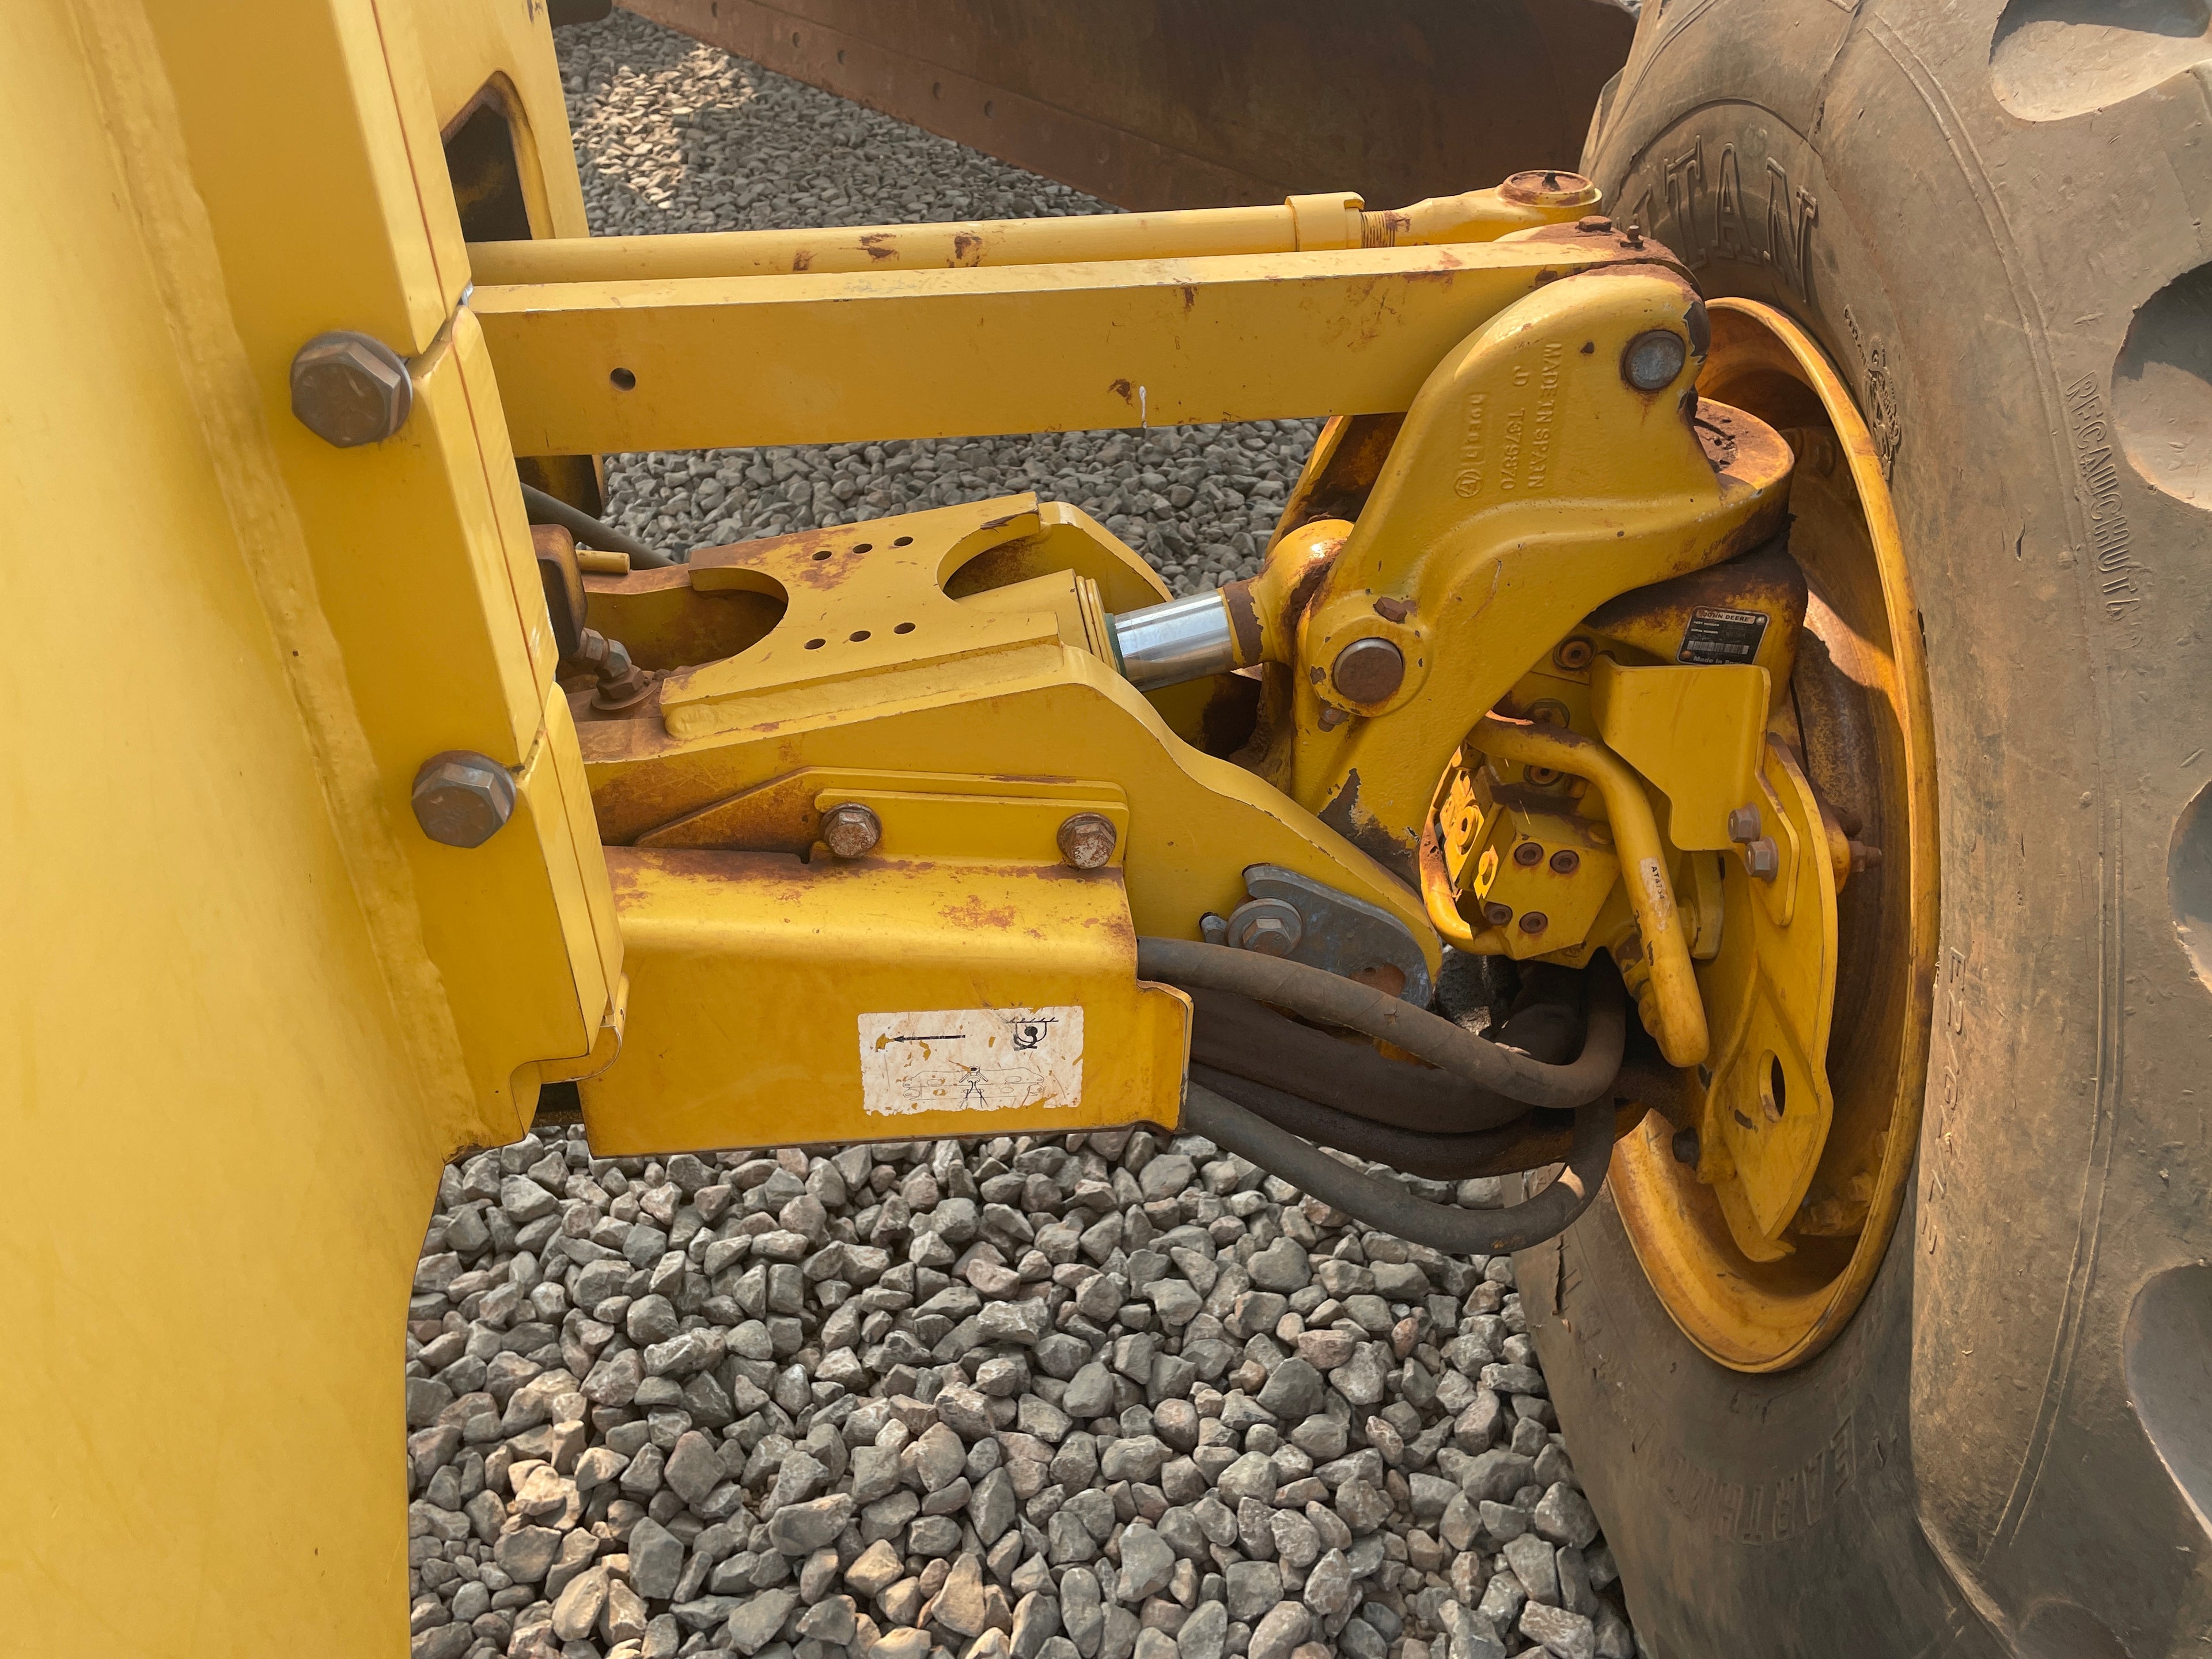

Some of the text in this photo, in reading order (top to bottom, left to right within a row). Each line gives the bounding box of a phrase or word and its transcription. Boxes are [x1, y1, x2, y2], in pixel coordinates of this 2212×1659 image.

[1513, 366, 1529, 387] JD
[1528, 343, 1562, 488] MADE IN SPAIN
